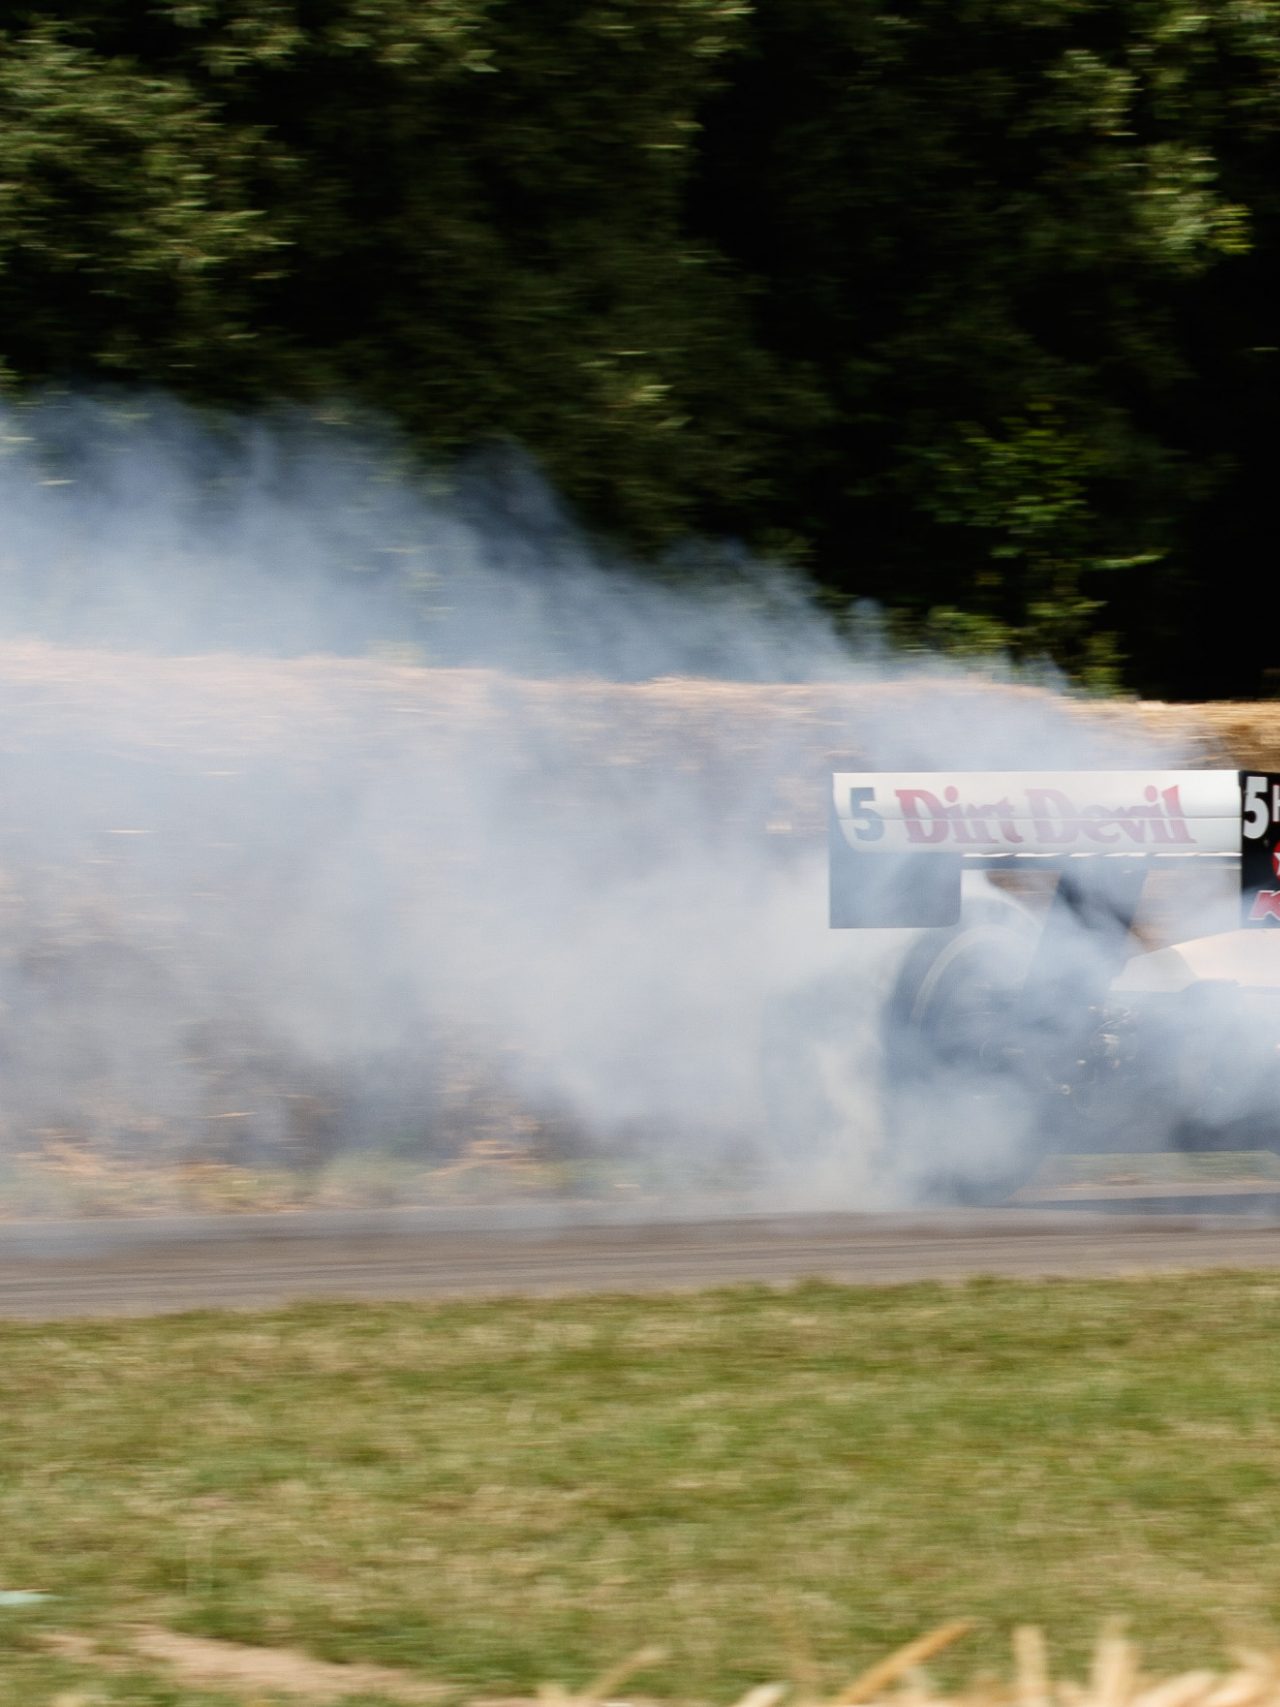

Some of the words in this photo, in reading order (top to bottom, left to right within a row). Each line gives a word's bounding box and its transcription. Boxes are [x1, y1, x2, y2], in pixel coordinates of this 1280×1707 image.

[849, 787, 885, 842] 5
[894, 785, 1025, 844] Dirt
[1024, 784, 1198, 844] Devil
[1243, 776, 1269, 839] 5
